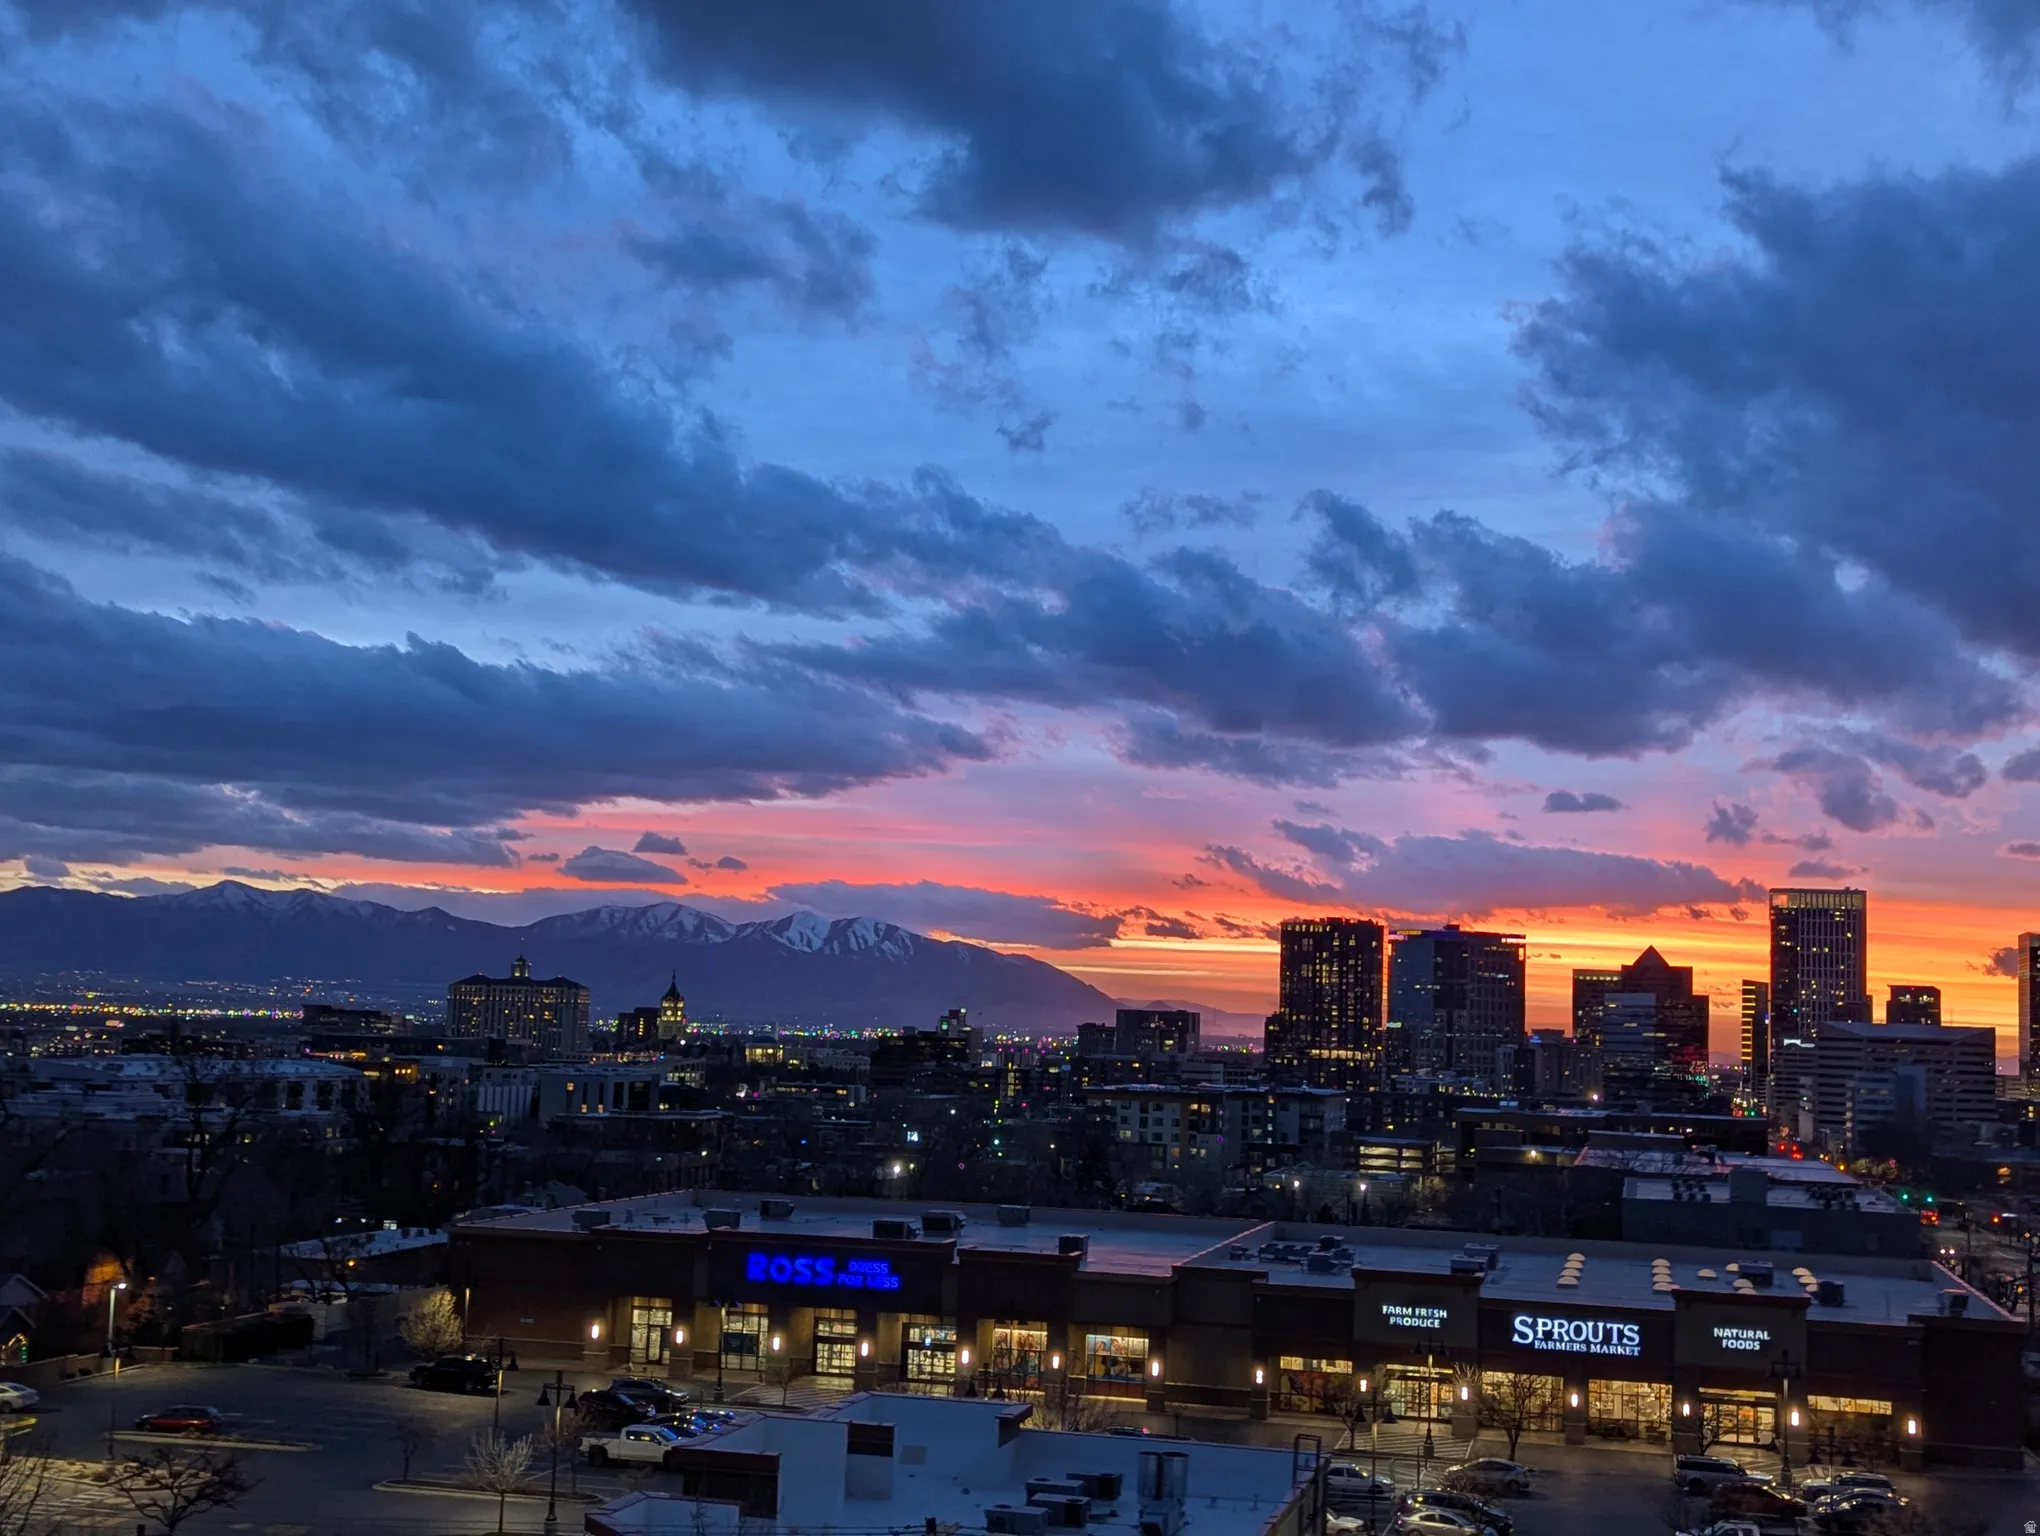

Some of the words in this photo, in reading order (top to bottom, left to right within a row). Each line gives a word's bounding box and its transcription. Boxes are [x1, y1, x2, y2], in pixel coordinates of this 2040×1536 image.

[747, 1252, 835, 1286] ROSS
[848, 1260, 889, 1274] DRESS
[837, 1274, 863, 1288] FOR
[867, 1275, 900, 1289] LESS
[1382, 1305, 1412, 1316] FARM
[1415, 1307, 1448, 1319] FRESH
[1389, 1316, 1441, 1328] PRODUCE
[1512, 1315, 1640, 1345] SPROUTS
[1713, 1327, 1771, 1340] NATURAL
[1534, 1340, 1587, 1352] FARMERS
[1589, 1343, 1641, 1356] MARKET
[1722, 1339, 1761, 1351] FOODS
